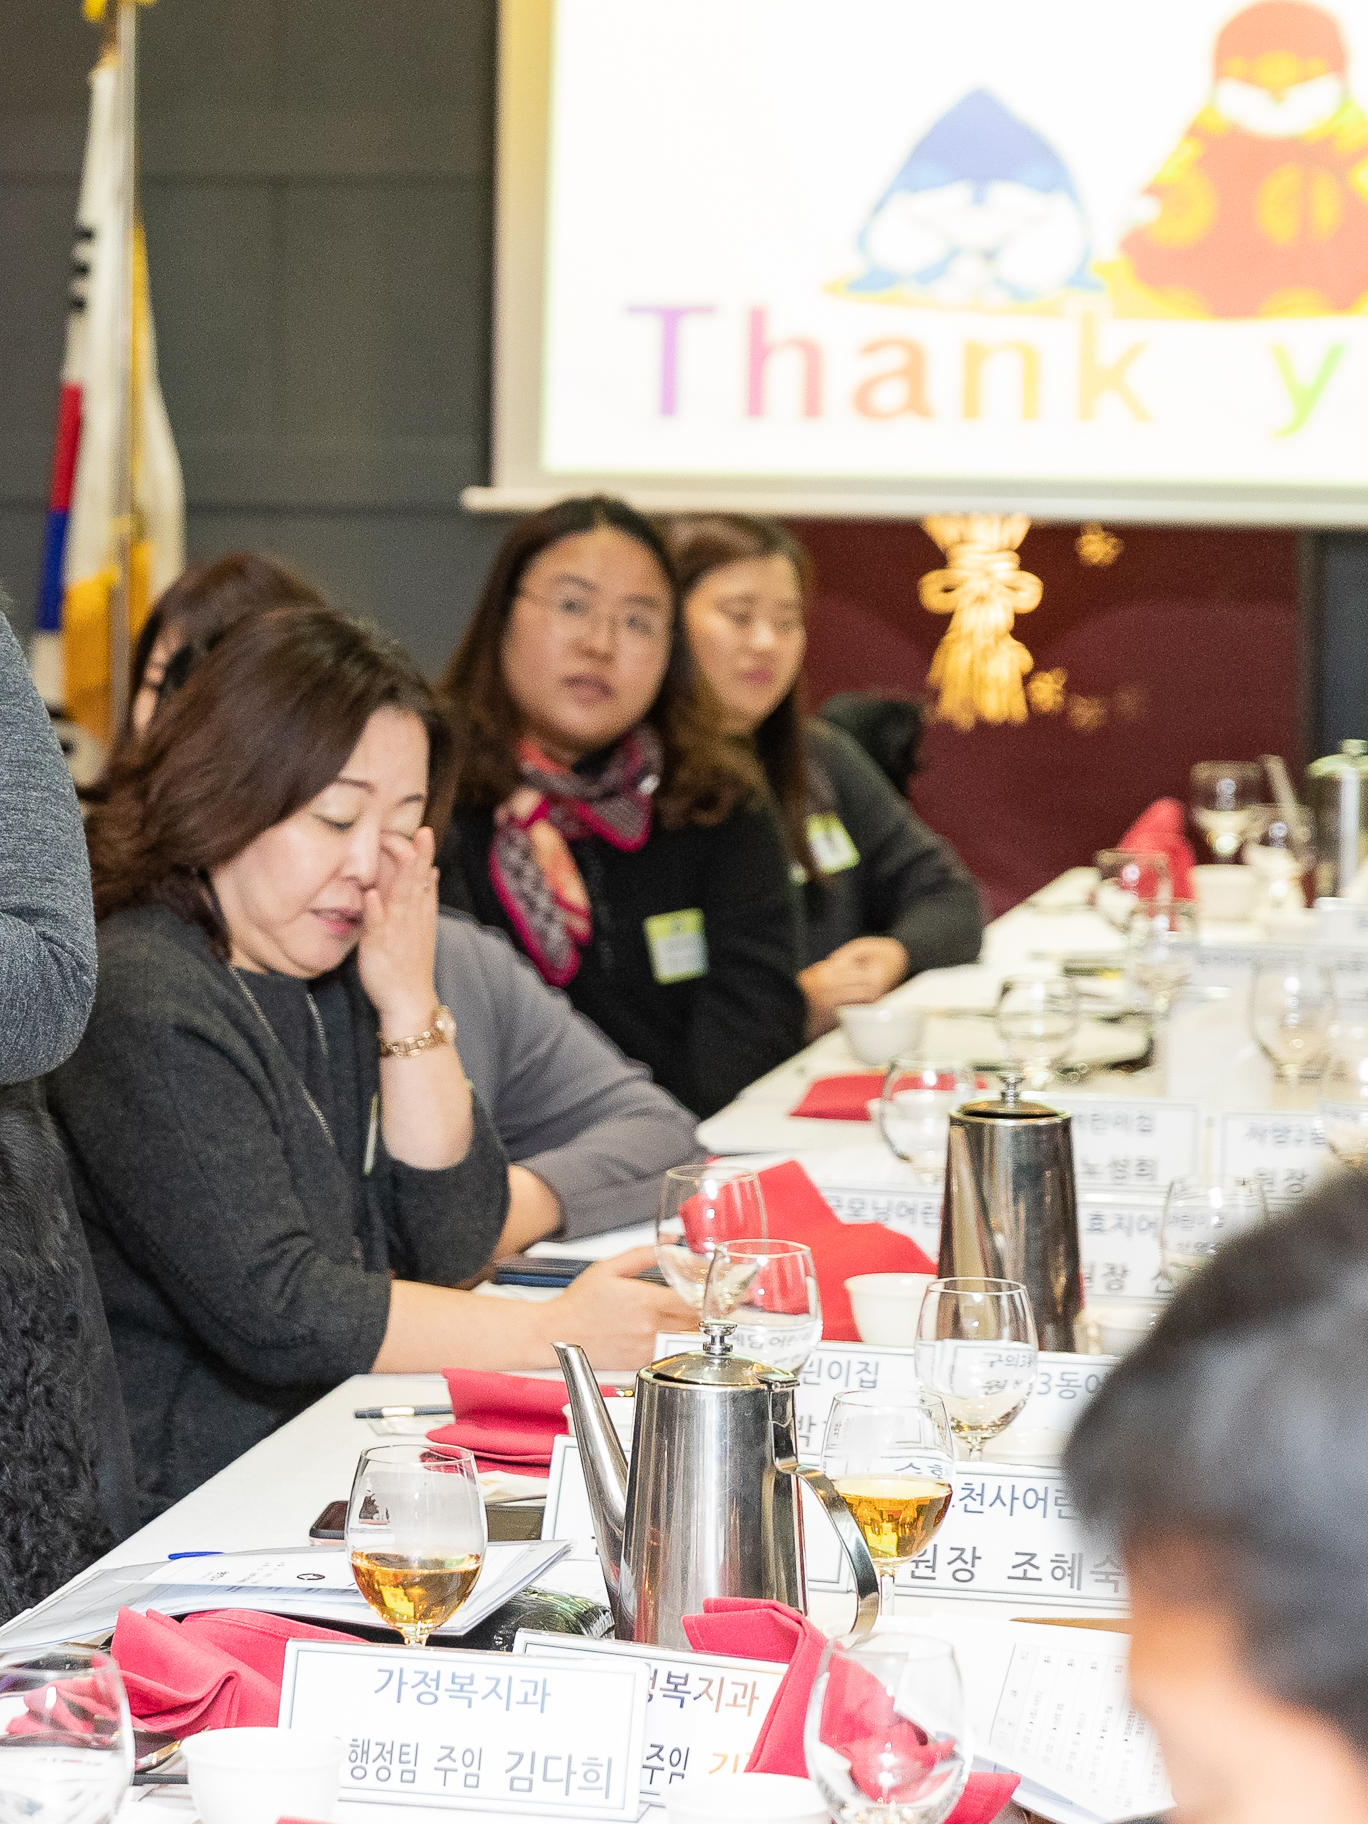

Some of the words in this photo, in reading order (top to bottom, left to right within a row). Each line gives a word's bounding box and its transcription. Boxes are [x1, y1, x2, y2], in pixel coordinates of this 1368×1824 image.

[626, 303, 1156, 422] Thank
[951, 1481, 1078, 1521] 천사어린
[1007, 1550, 1127, 1594] 조혜숙
[373, 1666, 552, 1714] 가정복지과
[347, 1737, 420, 1784] 행정팀
[433, 1743, 483, 1789] 주임
[504, 1749, 613, 1800] 김다희
